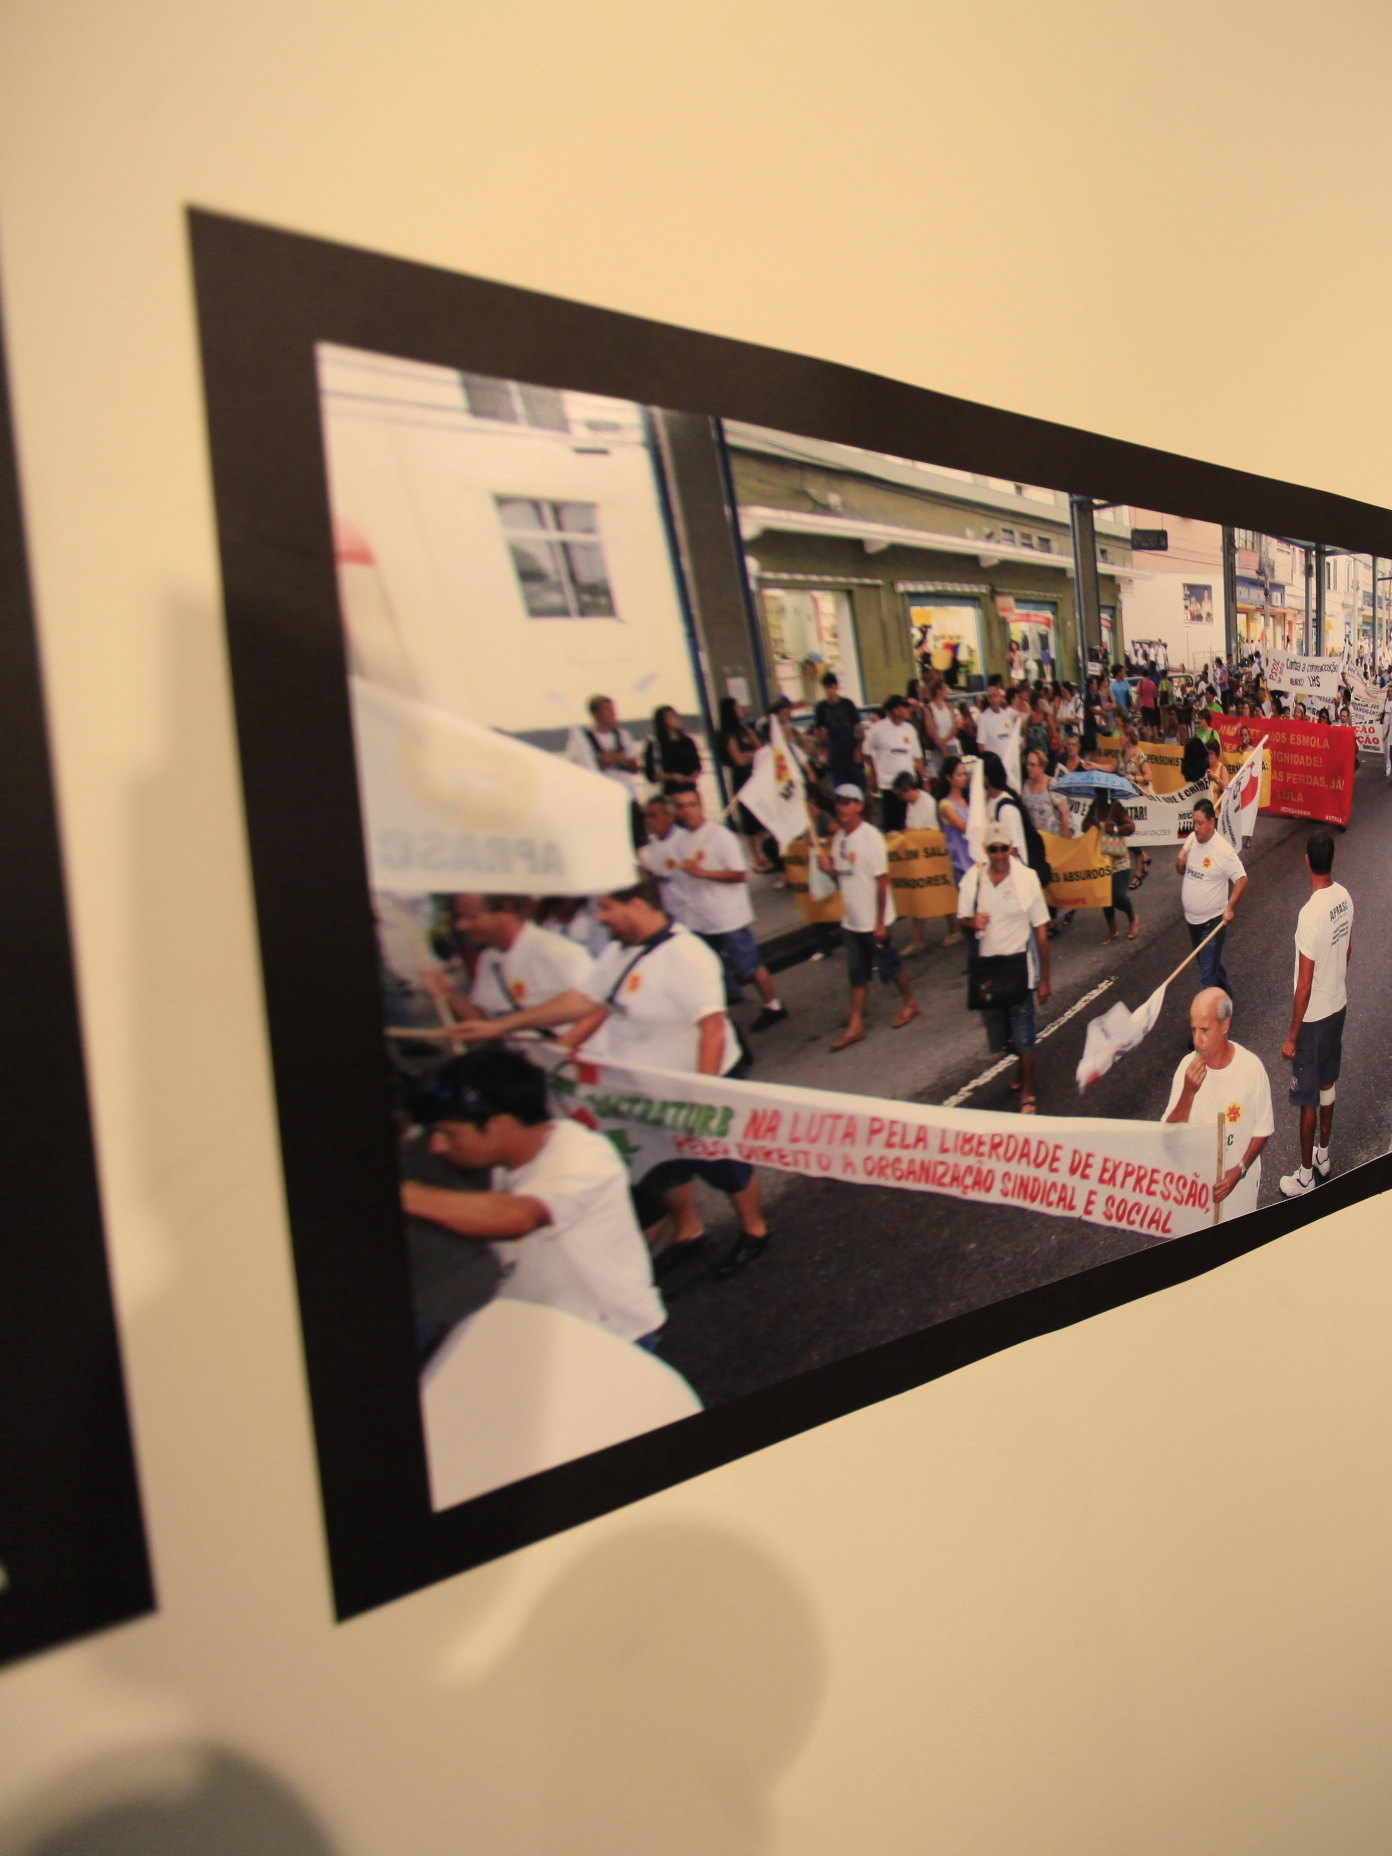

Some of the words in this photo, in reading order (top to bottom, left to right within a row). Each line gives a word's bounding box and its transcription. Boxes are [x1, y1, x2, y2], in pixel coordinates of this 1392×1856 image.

[1269, 658, 1281, 681] PSOL
[1290, 733, 1330, 750] ESMOLA
[1062, 865, 1112, 882] ABSURDOS
[743, 1108, 782, 1141] NA
[788, 1112, 858, 1146] LUTA
[866, 1116, 928, 1150] PELA
[939, 1127, 1064, 1173] LIBERDADE
[1068, 1148, 1096, 1180] DE
[1097, 1156, 1211, 1215] EXPRESSÃO,
[862, 1154, 996, 1196] ORGANIZAÇÃO
[999, 1170, 1077, 1212] SINDICAL
[1082, 1189, 1098, 1216] E
[1102, 1194, 1173, 1235] SOCIAL
